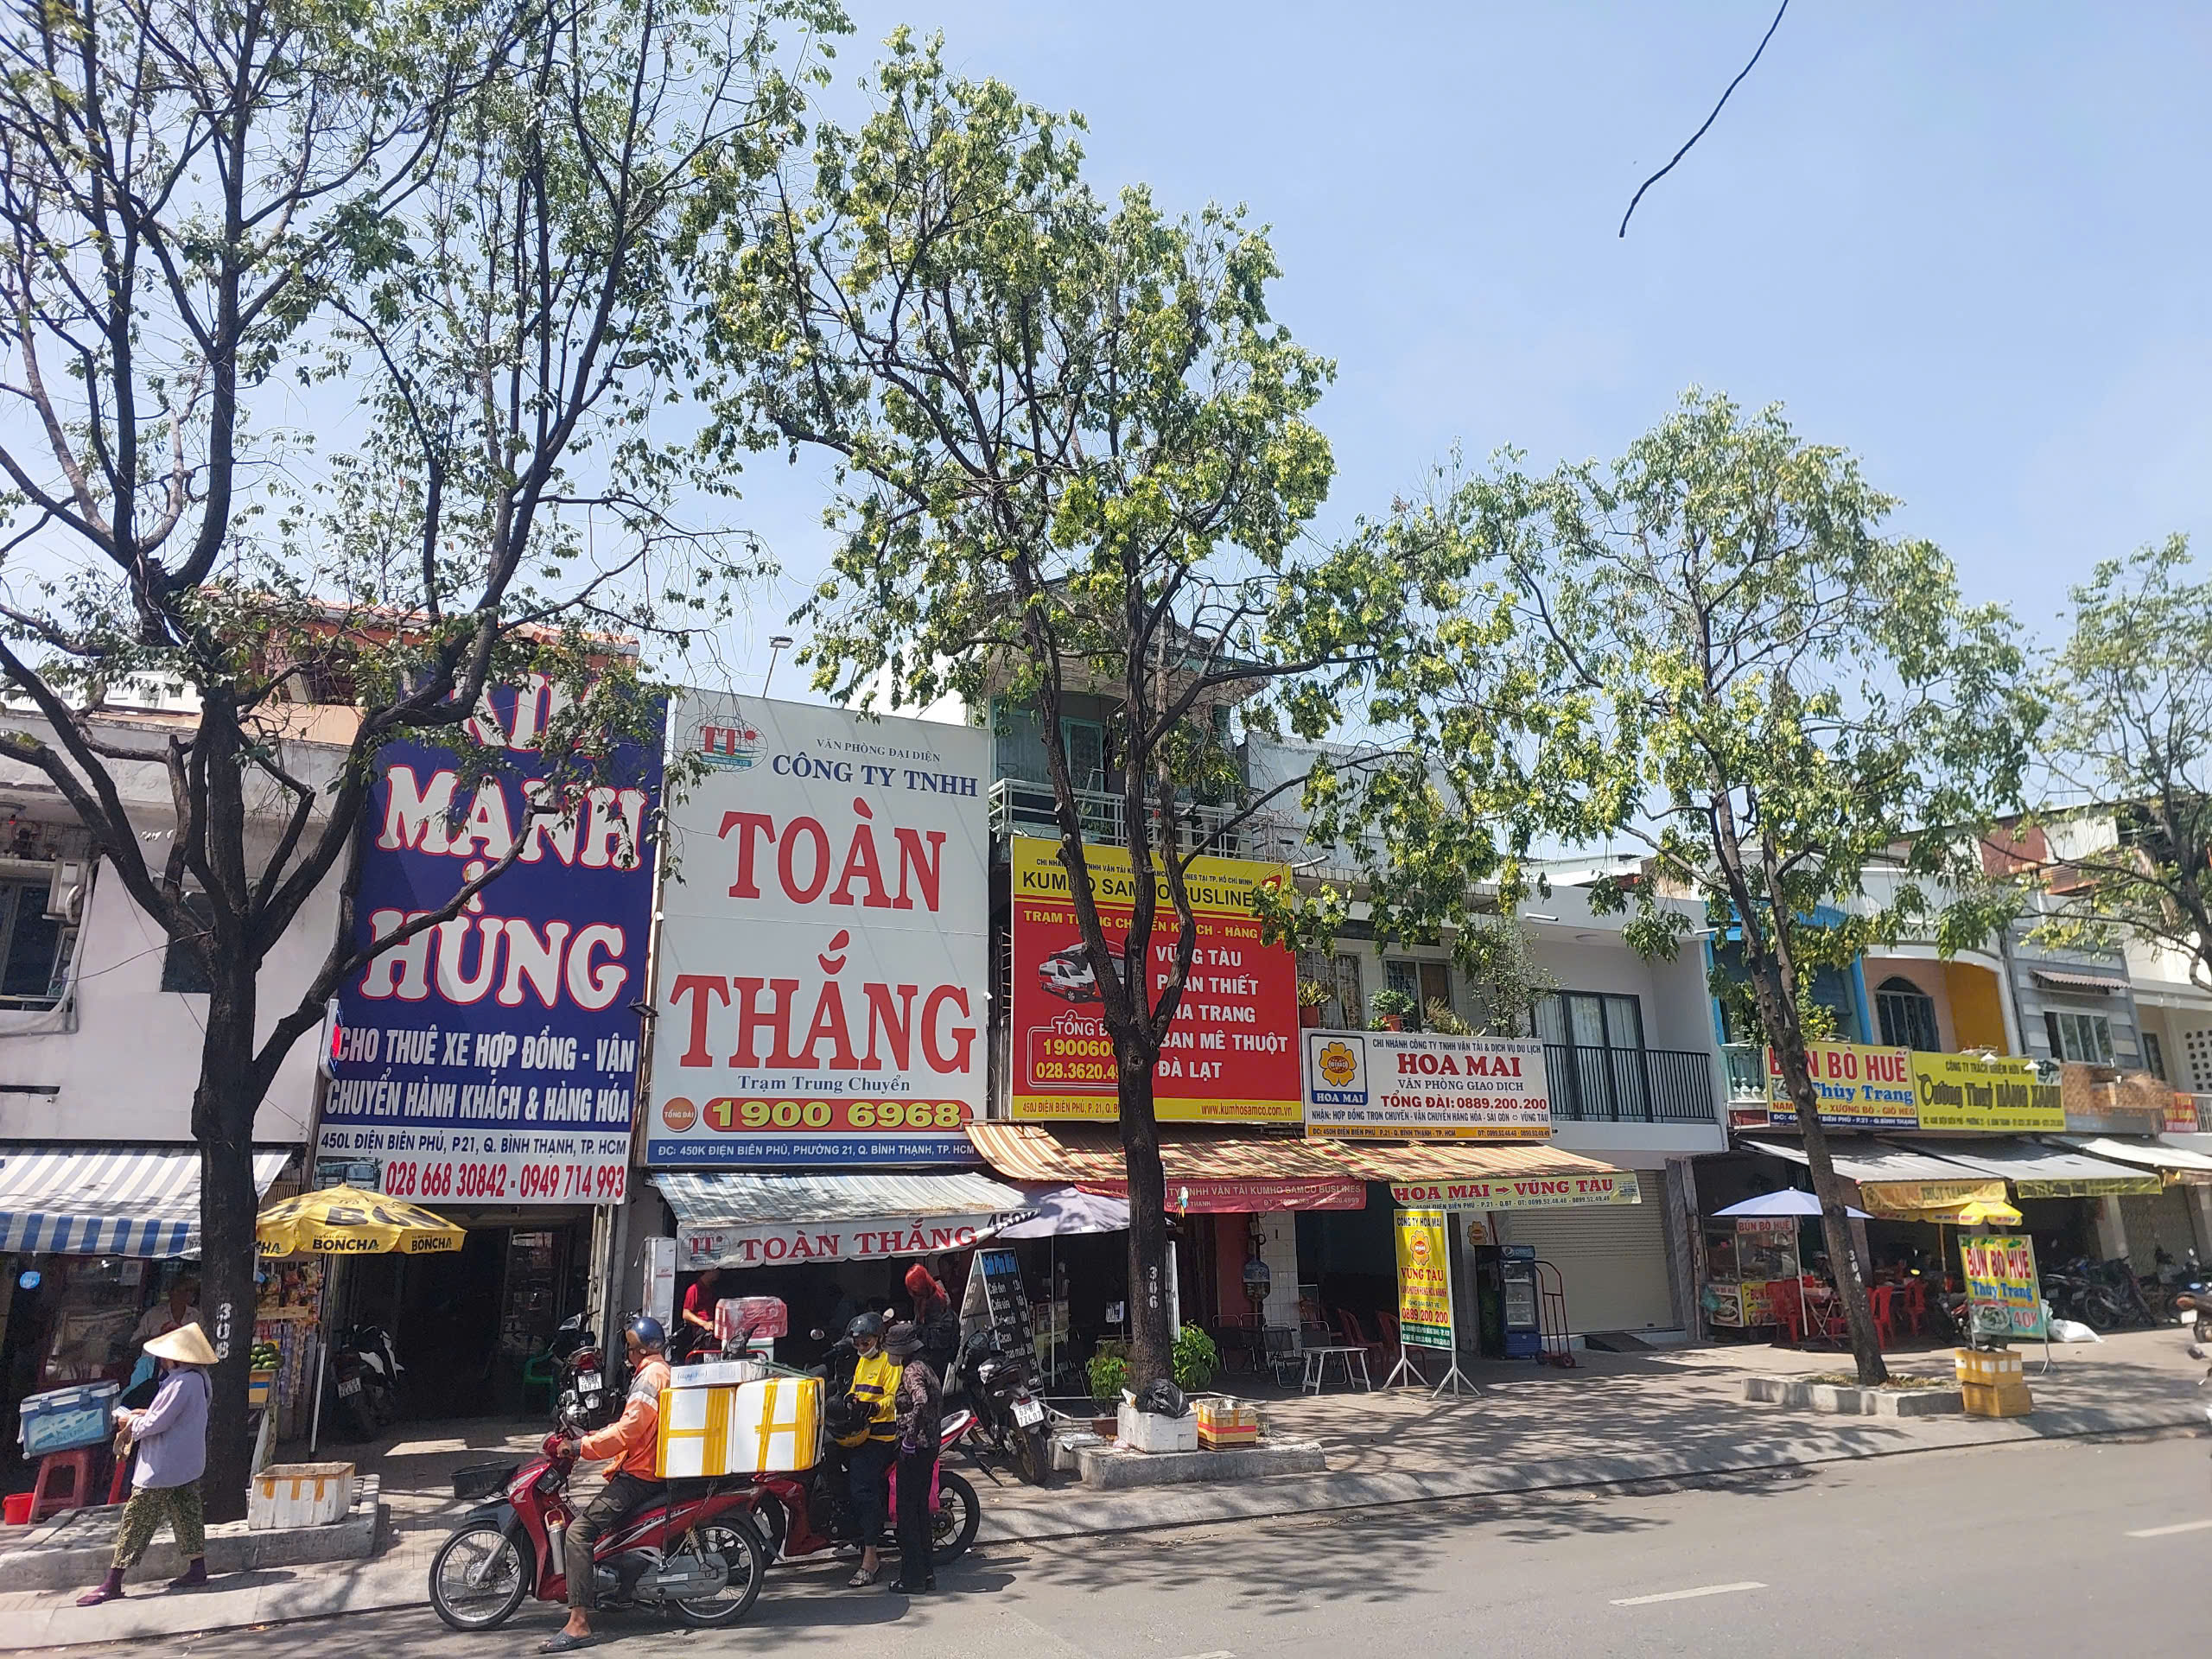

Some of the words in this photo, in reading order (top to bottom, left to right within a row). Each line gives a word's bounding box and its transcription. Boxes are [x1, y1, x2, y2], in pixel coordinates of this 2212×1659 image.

[817, 739, 842, 750] VĂN
[845, 742, 886, 756] PHÒNG
[888, 747, 910, 760] ĐẠI
[912, 750, 941, 763] DIỆN
[772, 753, 853, 784] CÔNG
[861, 765, 896, 786] TY
[904, 769, 978, 798] TNHH
[717, 797, 947, 912] TOÀN
[1023, 910, 1063, 925] TRẠM
[1225, 925, 1258, 939] HÀNG
[1155, 943, 1203, 965] VŨG
[1208, 945, 1243, 967] TÀU
[1208, 972, 1259, 995] THIẾT
[669, 929, 976, 1074] THẮNG
[1055, 1014, 1095, 1036] TỔNG
[1198, 1005, 1256, 1023] TRANG
[338, 1027, 379, 1062] CHO
[386, 1025, 439, 1065] THUÊ
[442, 1032, 471, 1067] XE
[475, 1031, 517, 1076] HỢP
[521, 1025, 576, 1071] ĐỒNG
[596, 1033, 635, 1080] VẬN
[1200, 1030, 1226, 1051] MÊ
[1232, 1032, 1288, 1055] THUỘT
[1372, 1039, 1383, 1048] CHI
[1386, 1039, 1408, 1049] NHÁNH
[1410, 1038, 1427, 1050] CÔNG
[1428, 1041, 1438, 1050] TY
[1439, 1041, 1455, 1051] TNHH
[1458, 1041, 1471, 1052] VẬN
[1491, 1043, 1506, 1053] DỊCH
[1507, 1044, 1516, 1054] VỤ
[1517, 1044, 1526, 1053] DU
[1527, 1044, 1541, 1055] LỊCH
[1158, 1058, 1182, 1077] ĐÀ
[1190, 1061, 1223, 1081] LẠT
[1396, 1053, 1460, 1076] HOA
[1465, 1055, 1522, 1077] MAI
[1827, 1046, 1858, 1080] BÒ
[1865, 1051, 1908, 1083] HUẾ
[325, 1066, 403, 1116] CHUYỂN
[404, 1075, 458, 1119] HÀNH
[460, 1078, 522, 1121] KHÁCH
[524, 1090, 540, 1122] &
[543, 1080, 593, 1122] HÀNG
[595, 1083, 630, 1123] HÓA
[738, 1076, 786, 1092] Trạm
[791, 1077, 843, 1094] Trung
[849, 1075, 911, 1095] Chuyển
[1397, 1077, 1421, 1090] VĂN
[1425, 1077, 1464, 1090] PHÒNG
[1467, 1081, 1494, 1090] GIAO
[1497, 1082, 1524, 1093] DỊCH
[1861, 1084, 1915, 1106] Trang
[1039, 1099, 1053, 1115] ĐIỆN
[1055, 1099, 1071, 1113] BIÊN
[1316, 1092, 1339, 1103] HOA
[1343, 1093, 1363, 1103] MAI
[1381, 1089, 1422, 1108] TỔNG
[1426, 1094, 1455, 1109] ĐÀI:
[1457, 1096, 1548, 1109] 0889.200.200
[712, 1101, 832, 1128] 1900
[848, 1101, 961, 1128] 6968
[1201, 1102, 1294, 1118] www.kumhosamco.com.vn
[1452, 1111, 1469, 1122] HÀNG
[321, 1133, 350, 1150] 450L
[354, 1129, 384, 1158] ĐIỆN
[388, 1130, 415, 1151] BIÊN
[418, 1130, 447, 1155] PHỦ,
[483, 1137, 498, 1154] Q.
[500, 1131, 530, 1154] BÌNH
[533, 1138, 576, 1159] THẠNH,
[581, 1140, 594, 1154] TP.
[598, 1140, 627, 1155] HCM
[658, 1143, 677, 1156] ĐC:
[679, 1144, 706, 1156] 450K
[709, 1142, 734, 1158] ĐIỆN
[737, 1142, 762, 1156] BIÊN
[793, 1141, 839, 1156] PHƯỜNG
[841, 1144, 855, 1158] 21,
[858, 1144, 868, 1157] Q.
[871, 1141, 895, 1156] BÌNH
[897, 1143, 935, 1159] THẠNH,
[937, 1144, 950, 1155] TP.
[953, 1144, 975, 1155] HCM
[385, 1160, 416, 1196] 028
[421, 1162, 452, 1197] 668
[456, 1162, 507, 1198] 30842
[519, 1163, 560, 1198] 0949
[563, 1165, 593, 1199] 714
[596, 1165, 626, 1199] 993
[1250, 1185, 1283, 1195] KUMHO
[1286, 1185, 1317, 1194] SAMCO
[1319, 1185, 1361, 1193] BUSLINES
[1393, 1186, 1442, 1201] HOA
[1447, 1184, 1491, 1198] MAI
[1514, 1179, 1570, 1196] VŨNG
[1576, 1176, 1613, 1193] TÀU
[1397, 1215, 1411, 1227] CÔNG
[1412, 1217, 1418, 1227] TY
[1421, 1217, 1431, 1227] HOA
[1433, 1217, 1442, 1227] MAI
[1738, 1219, 1757, 1231] BÚN
[1759, 1219, 1771, 1230] BÒ
[312, 1238, 379, 1251] BONCHA
[411, 1237, 453, 1252] BONCHA
[737, 1230, 840, 1261] TOÀN
[854, 1219, 977, 1255] THẮNG
[1967, 1242, 1989, 1277] BÚN
[1401, 1264, 1424, 1281] VŨNG
[1426, 1266, 1444, 1281] TÀU
[1149, 1266, 1158, 1309] 306
[2000, 1283, 2032, 1302] Trang
[1402, 1307, 1419, 1321] 0889
[1421, 1310, 1433, 1323] 200
[1435, 1311, 1448, 1324] 200
